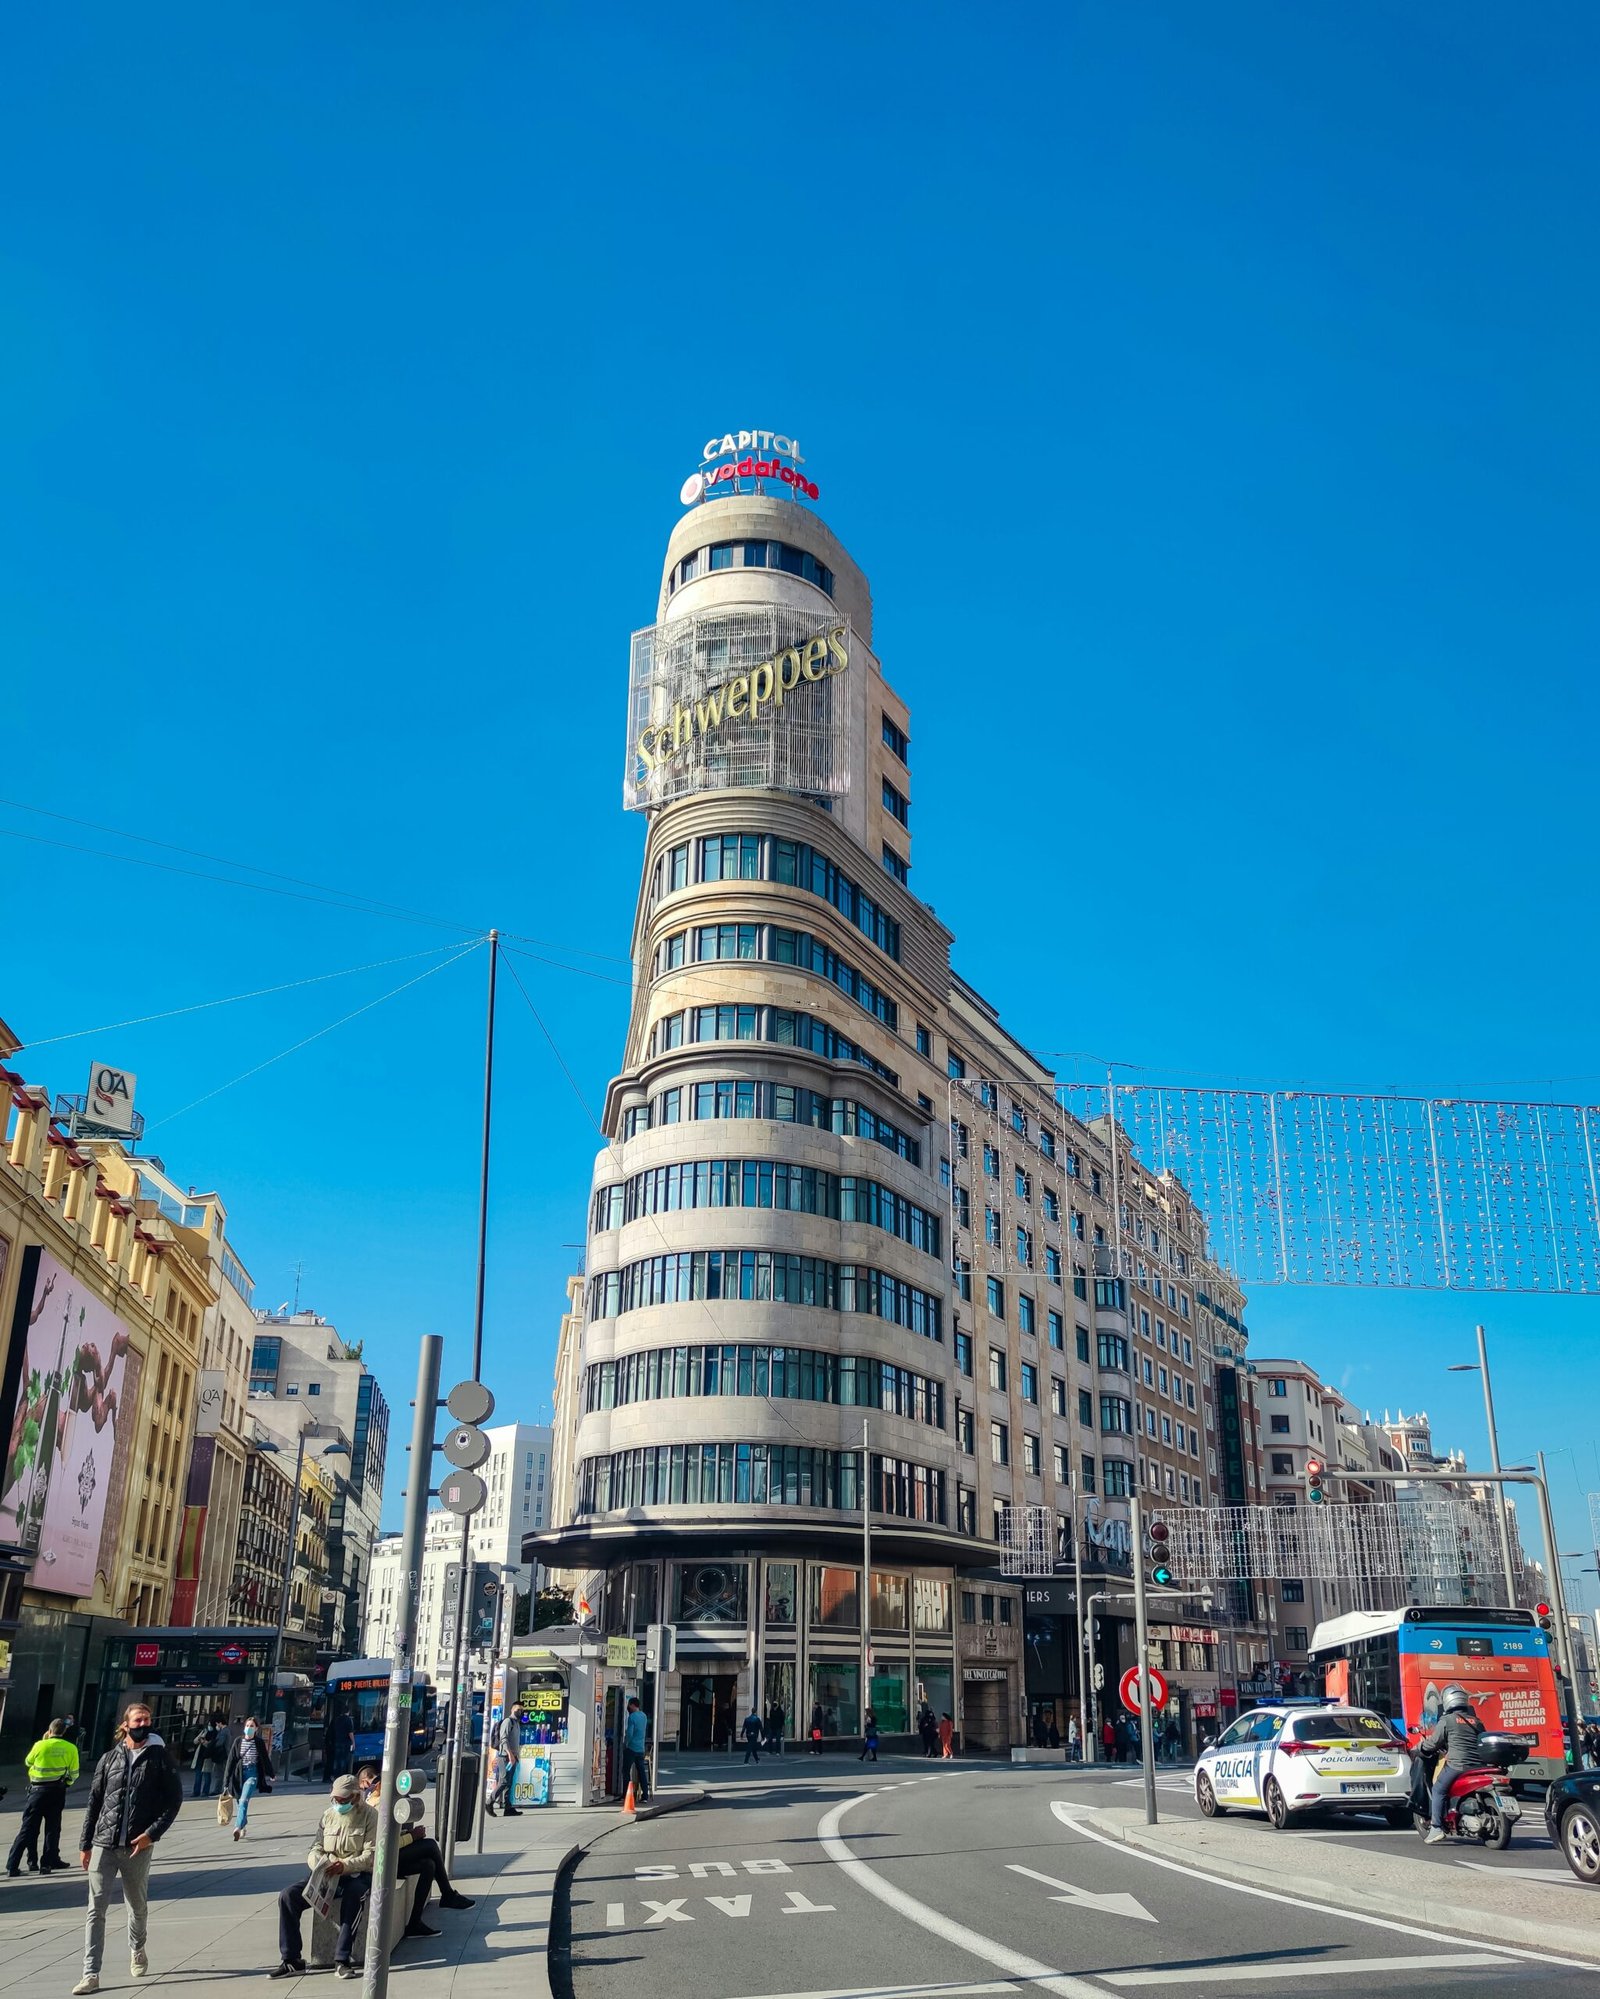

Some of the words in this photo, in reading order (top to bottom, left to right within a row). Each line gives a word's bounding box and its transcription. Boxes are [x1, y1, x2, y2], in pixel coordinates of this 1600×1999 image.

[702, 430, 806, 464] CAPITOL
[704, 456, 819, 500] vodafone
[635, 626, 849, 790] Schweppes
[1223, 1395, 1242, 1499] HOTEL
[1503, 1642, 1523, 1650] 2189
[1499, 1691, 1527, 1701] VOLAR
[1530, 1690, 1541, 1699] ES
[1503, 1699, 1540, 1709] HUMANO
[1499, 1708, 1546, 1719] ATERRIZAR
[1503, 1718, 1514, 1727] ES
[1517, 1716, 1546, 1726] DIVINO
[1364, 1719, 1383, 1730] 092
[1214, 1755, 1253, 1778] POLICÍA
[515, 1783, 535, 1801] 0,50
[1346, 1784, 1365, 1793] 7513
[634, 1859, 793, 1881] BUS
[606, 1891, 837, 1927] TAXI
